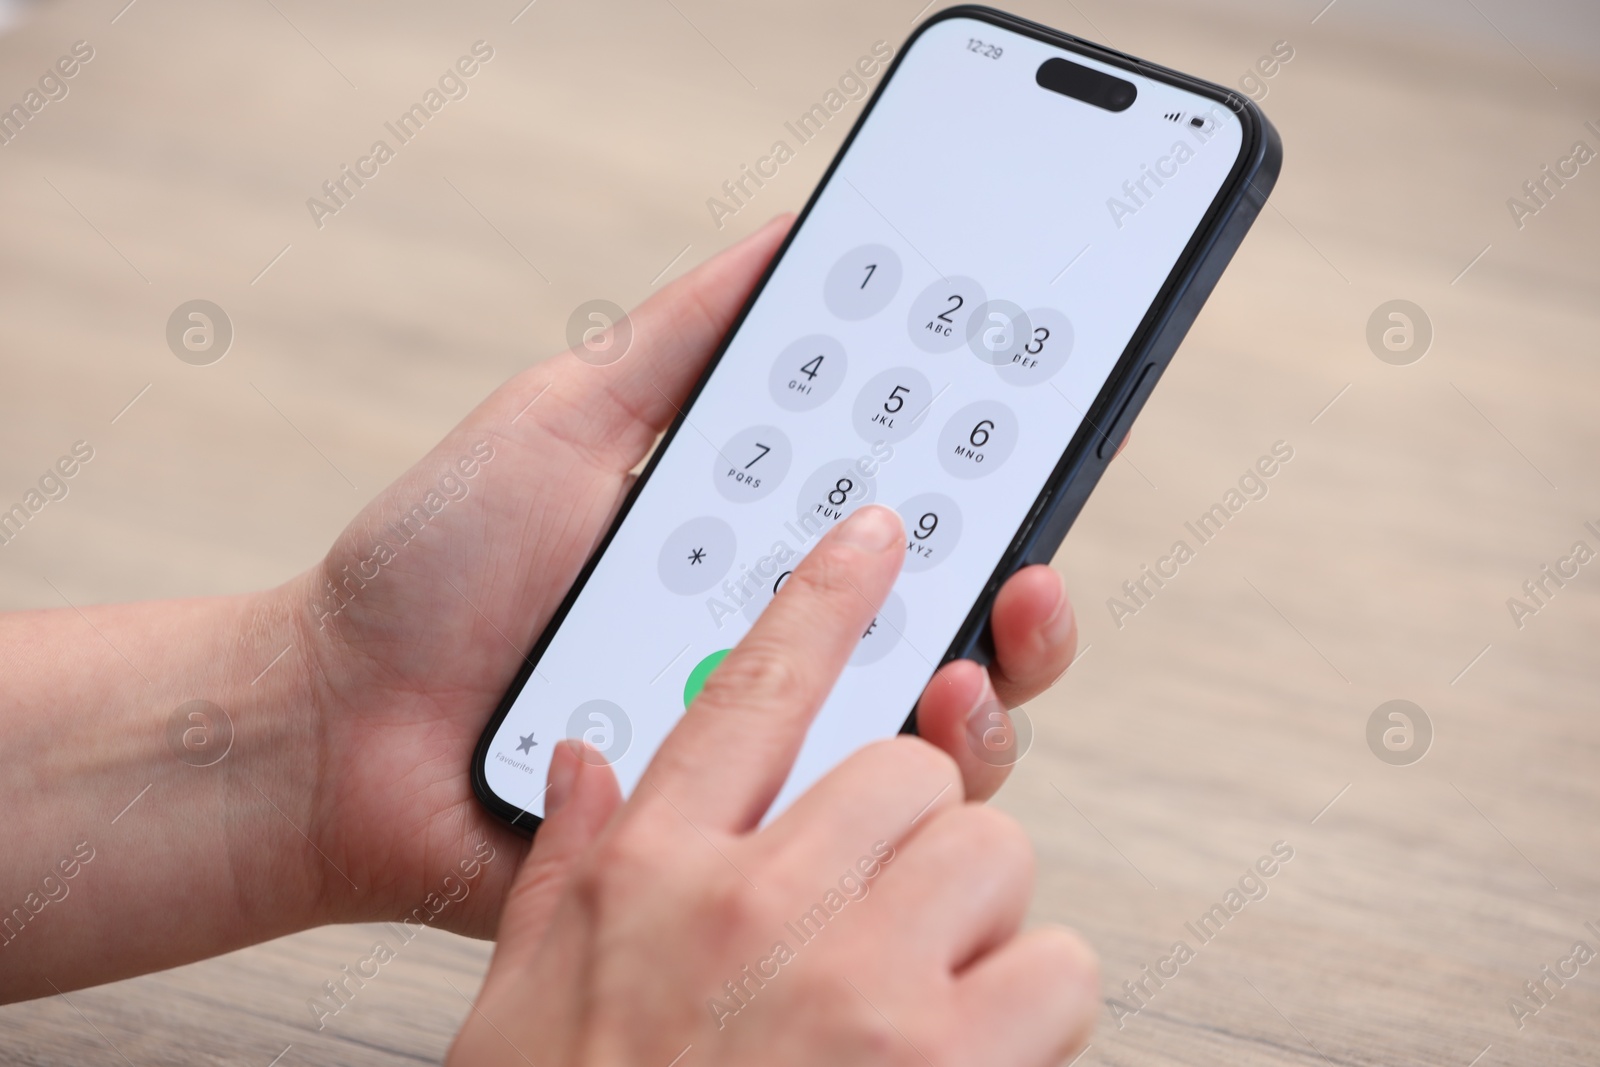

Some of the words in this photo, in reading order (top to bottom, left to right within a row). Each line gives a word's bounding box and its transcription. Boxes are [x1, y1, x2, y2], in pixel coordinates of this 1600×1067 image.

[967, 38, 1004, 60] 12:29
[860, 264, 877, 290] 1
[937, 295, 964, 323] 2
[925, 321, 953, 337] ABC
[1024, 327, 1050, 355] 3
[800, 355, 825, 381] 4
[1012, 353, 1039, 369] DEF
[788, 380, 812, 395] GHI
[884, 385, 911, 413] 5
[871, 413, 895, 429] JKL
[969, 419, 995, 447] 6
[744, 442, 771, 469] 7
[954, 445, 985, 463] MNO
[727, 469, 761, 489] PQRS
[828, 478, 853, 505] 8
[816, 504, 842, 521] TUV
[913, 512, 939, 540] 9
[906, 541, 933, 558] XYZ
[495, 752, 534, 775] Favourites
